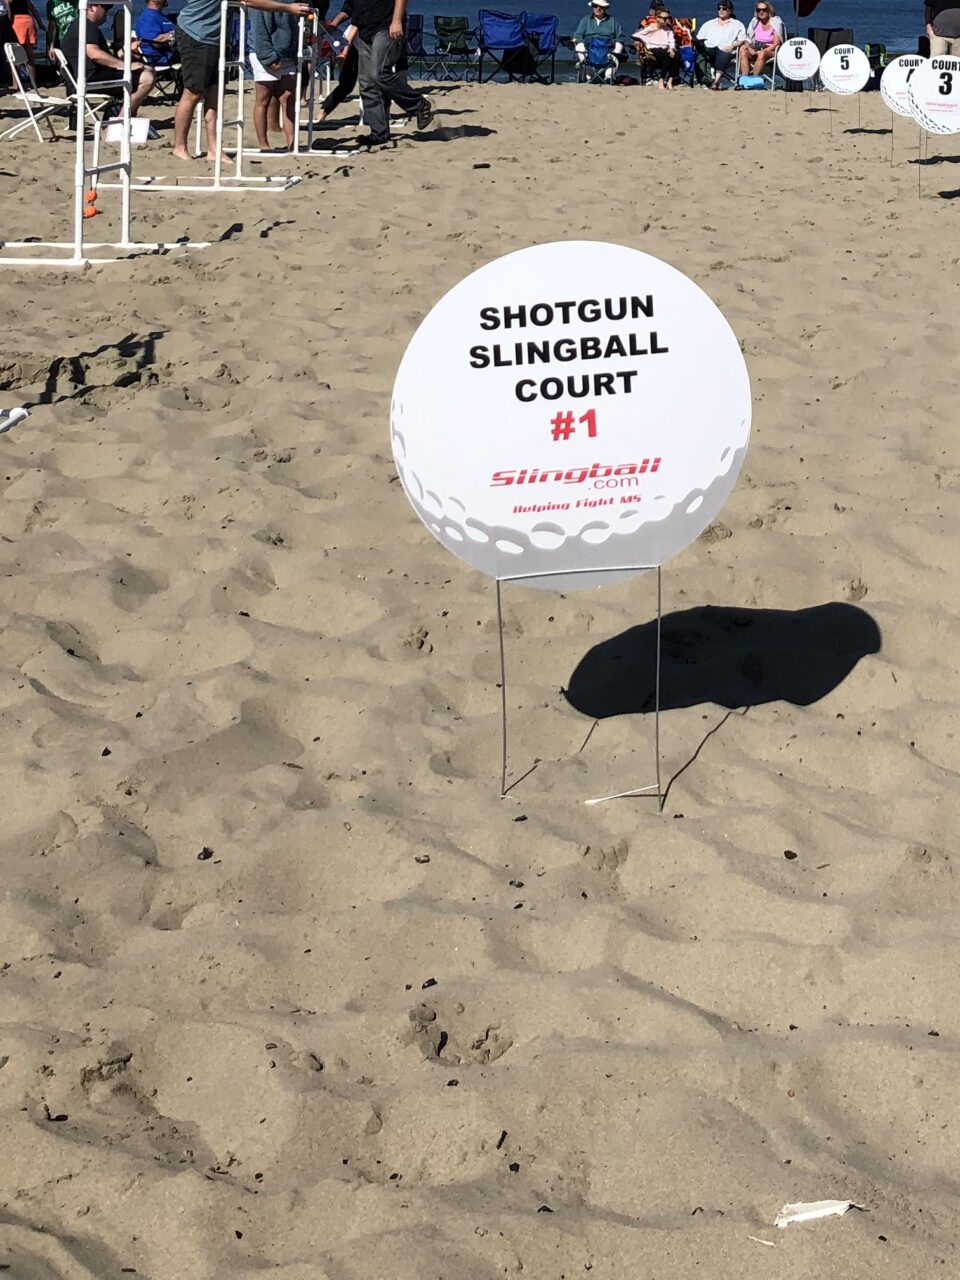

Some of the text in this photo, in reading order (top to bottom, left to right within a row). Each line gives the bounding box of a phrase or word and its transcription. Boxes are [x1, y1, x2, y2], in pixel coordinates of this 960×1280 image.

[794, 46, 803, 60] 6
[834, 47, 854, 55] COURT
[840, 55, 849, 70] 5
[938, 72, 953, 95] 3
[479, 294, 655, 331] SHOTGUN
[468, 331, 669, 369] SLINGBALL
[514, 370, 638, 402] COURT
[550, 408, 597, 441] #1
[489, 456, 662, 487] Slingball
[588, 476, 639, 491] .com
[512, 493, 642, 514] Helping Fight MS
